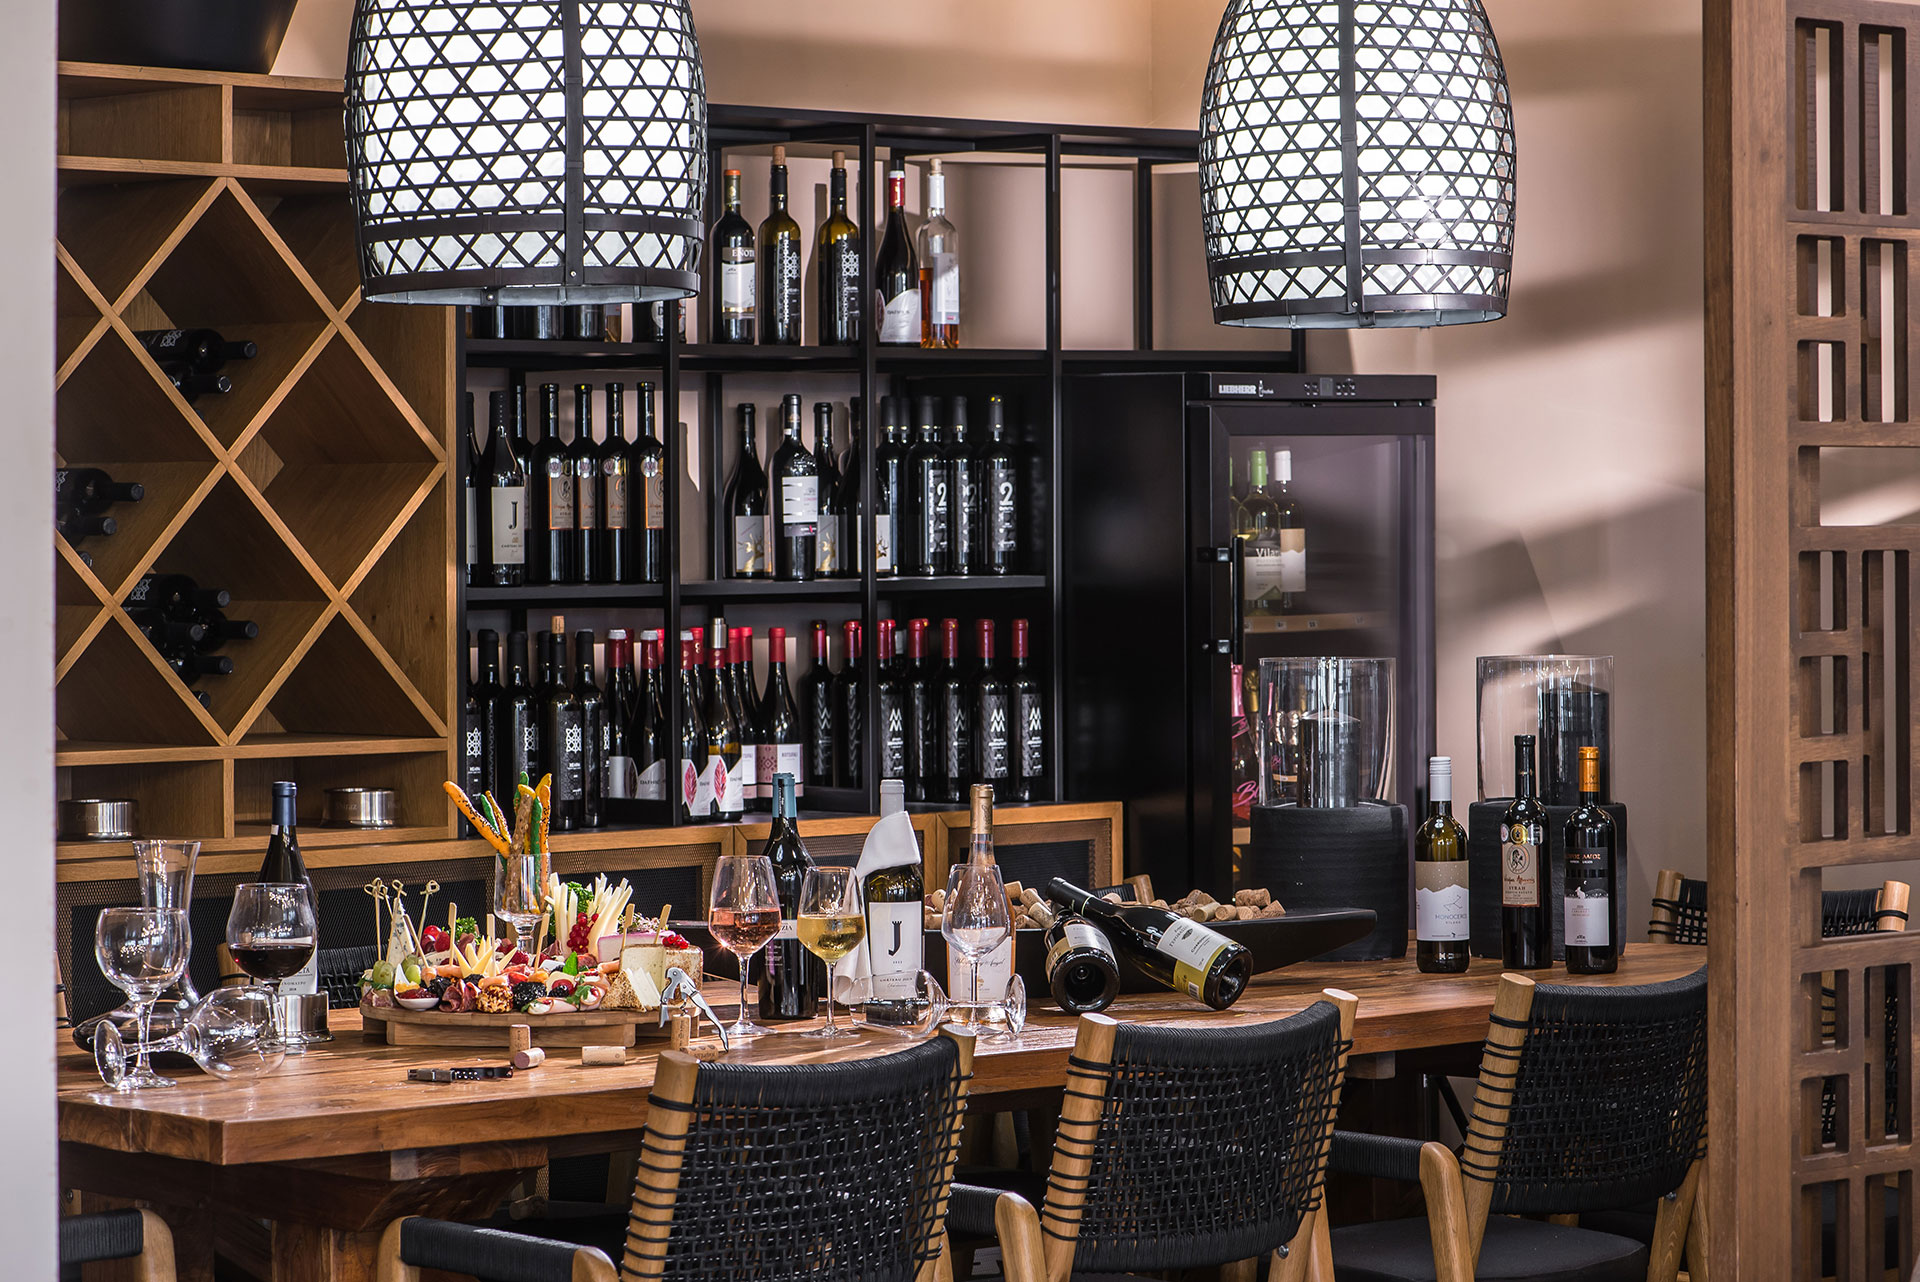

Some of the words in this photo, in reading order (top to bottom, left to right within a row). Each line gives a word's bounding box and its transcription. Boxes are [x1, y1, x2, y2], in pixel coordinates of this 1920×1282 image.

[1218, 384, 1257, 395] LIEBHERR
[936, 482, 947, 507] 2
[1000, 482, 1014, 506] 2
[508, 501, 519, 530] J
[888, 920, 902, 957] J
